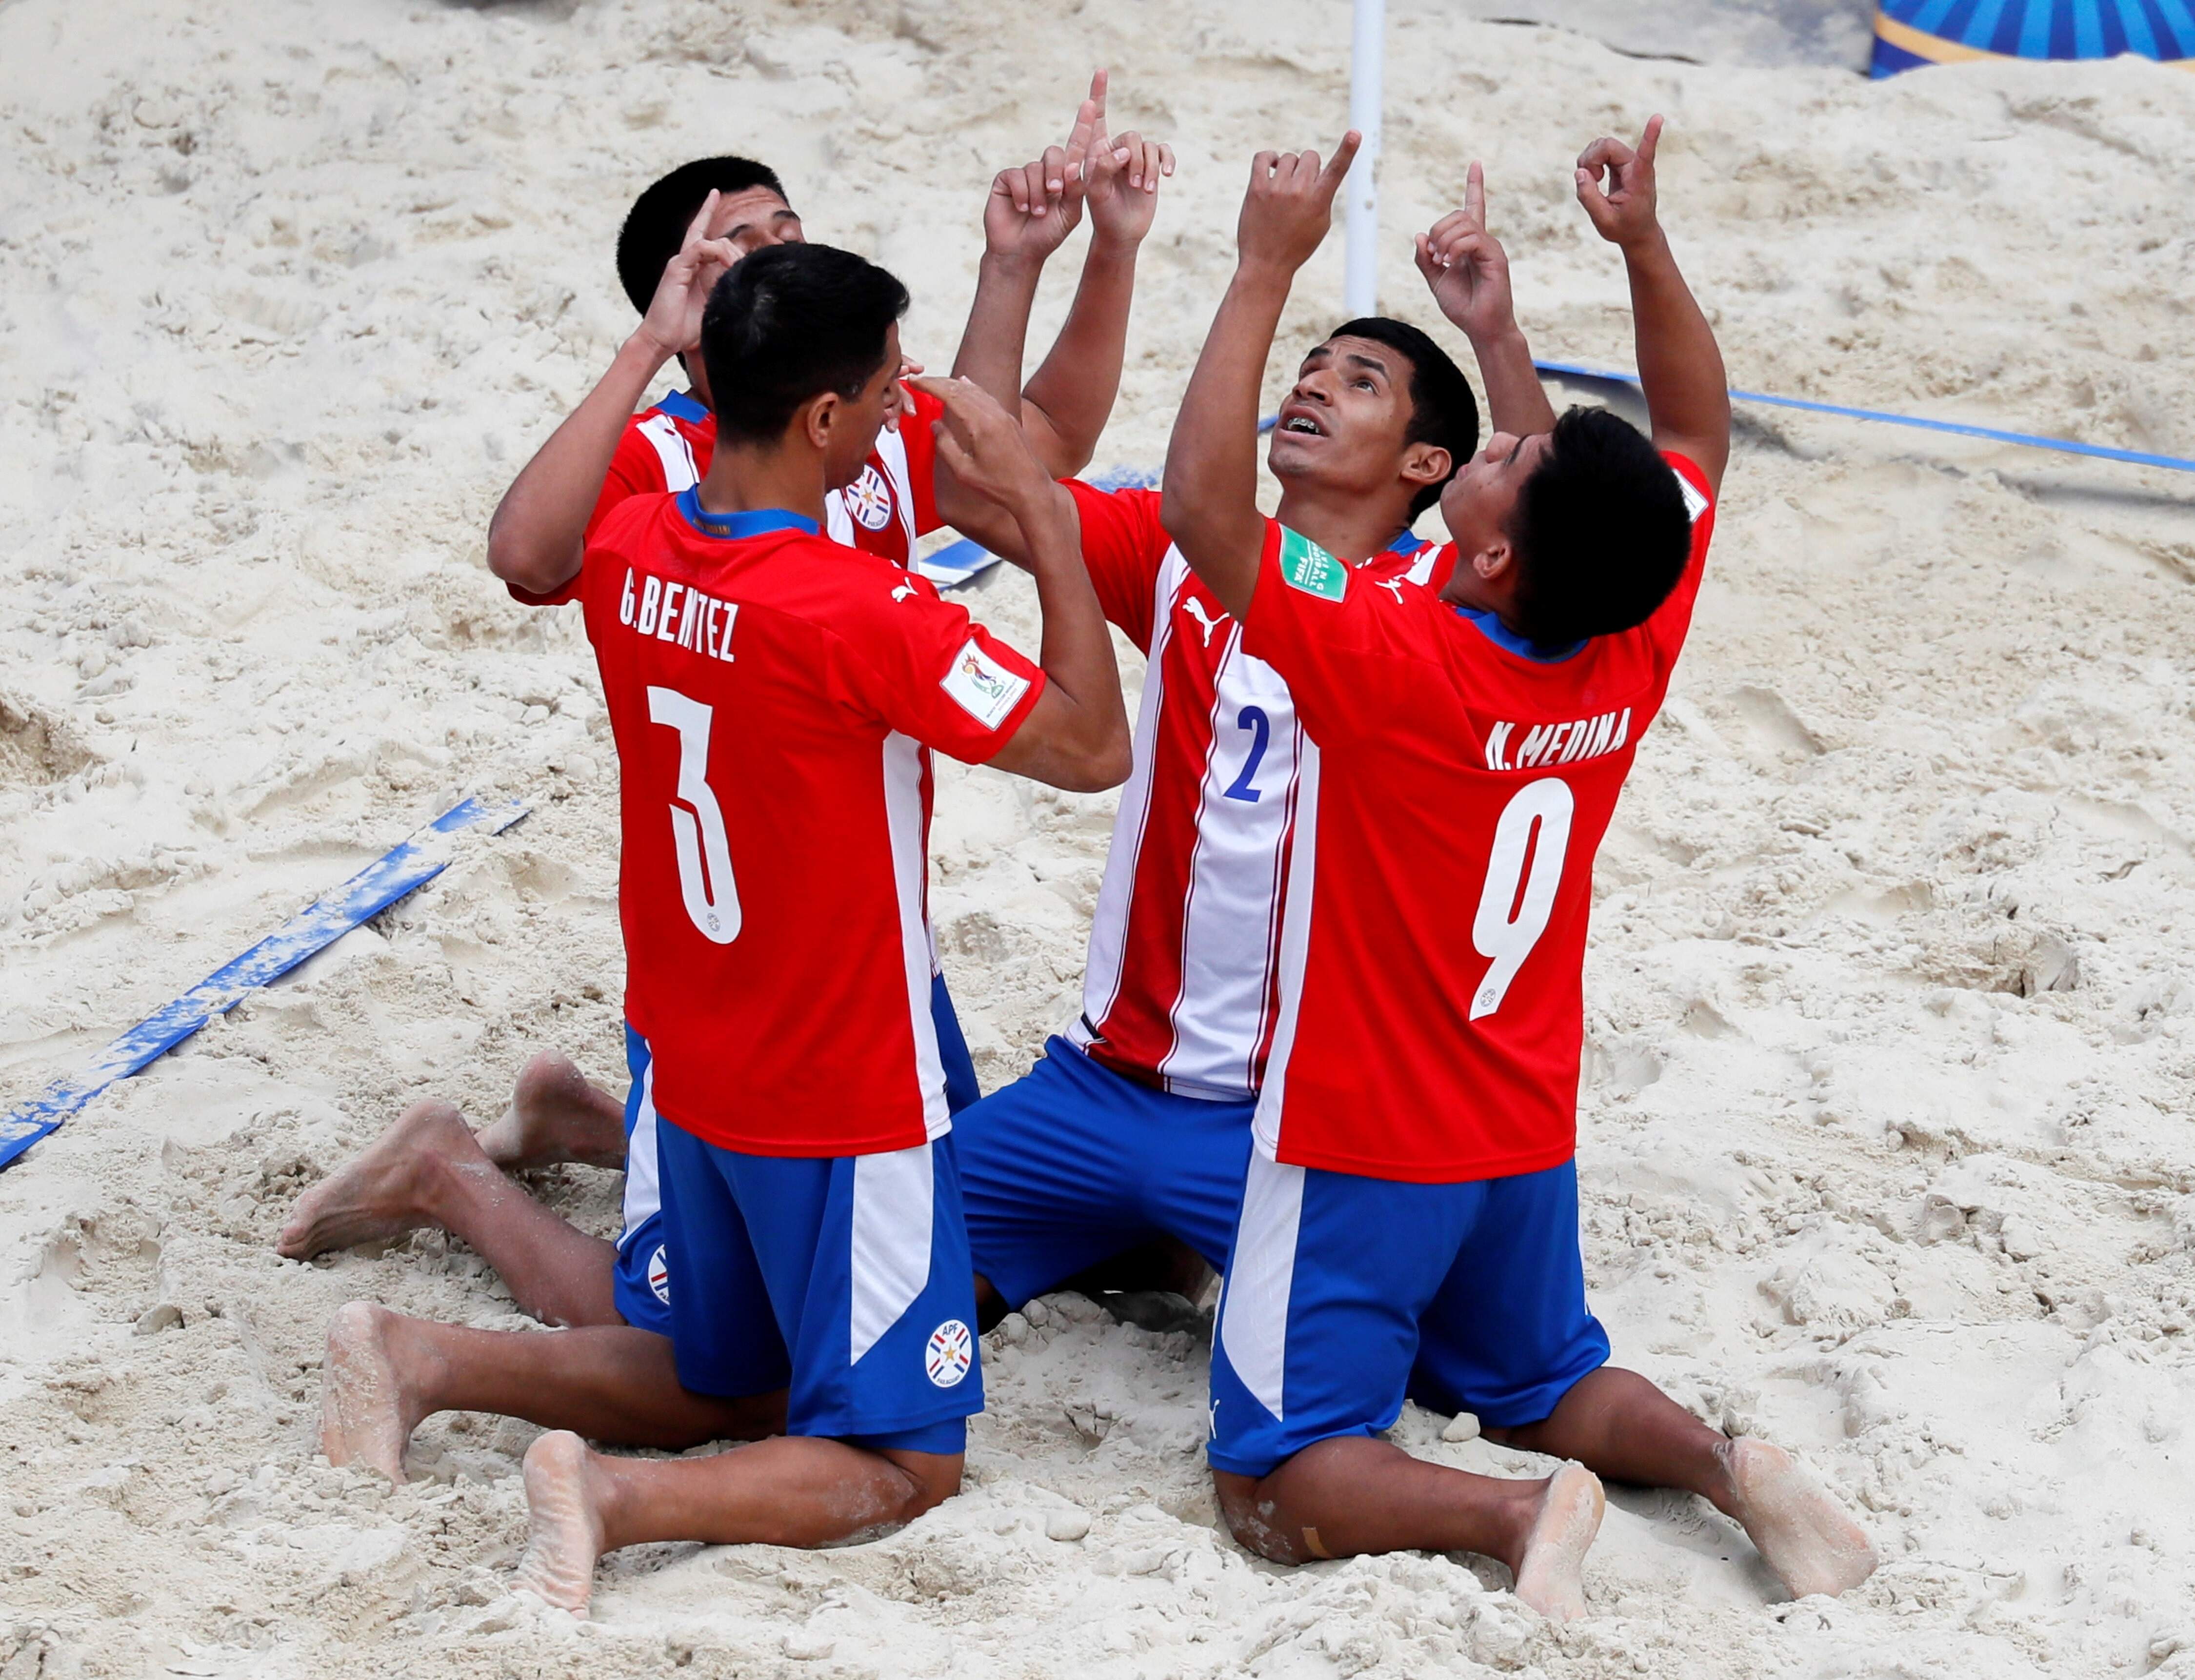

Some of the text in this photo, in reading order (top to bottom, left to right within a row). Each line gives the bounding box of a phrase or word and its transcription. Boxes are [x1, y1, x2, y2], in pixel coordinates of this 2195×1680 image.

[1294, 556, 1308, 582] FIFA
[1316, 550, 1329, 591] IVING
[1223, 705, 1270, 803] 2
[1469, 777, 1575, 1022] 9
[942, 1323, 958, 1336] APF
